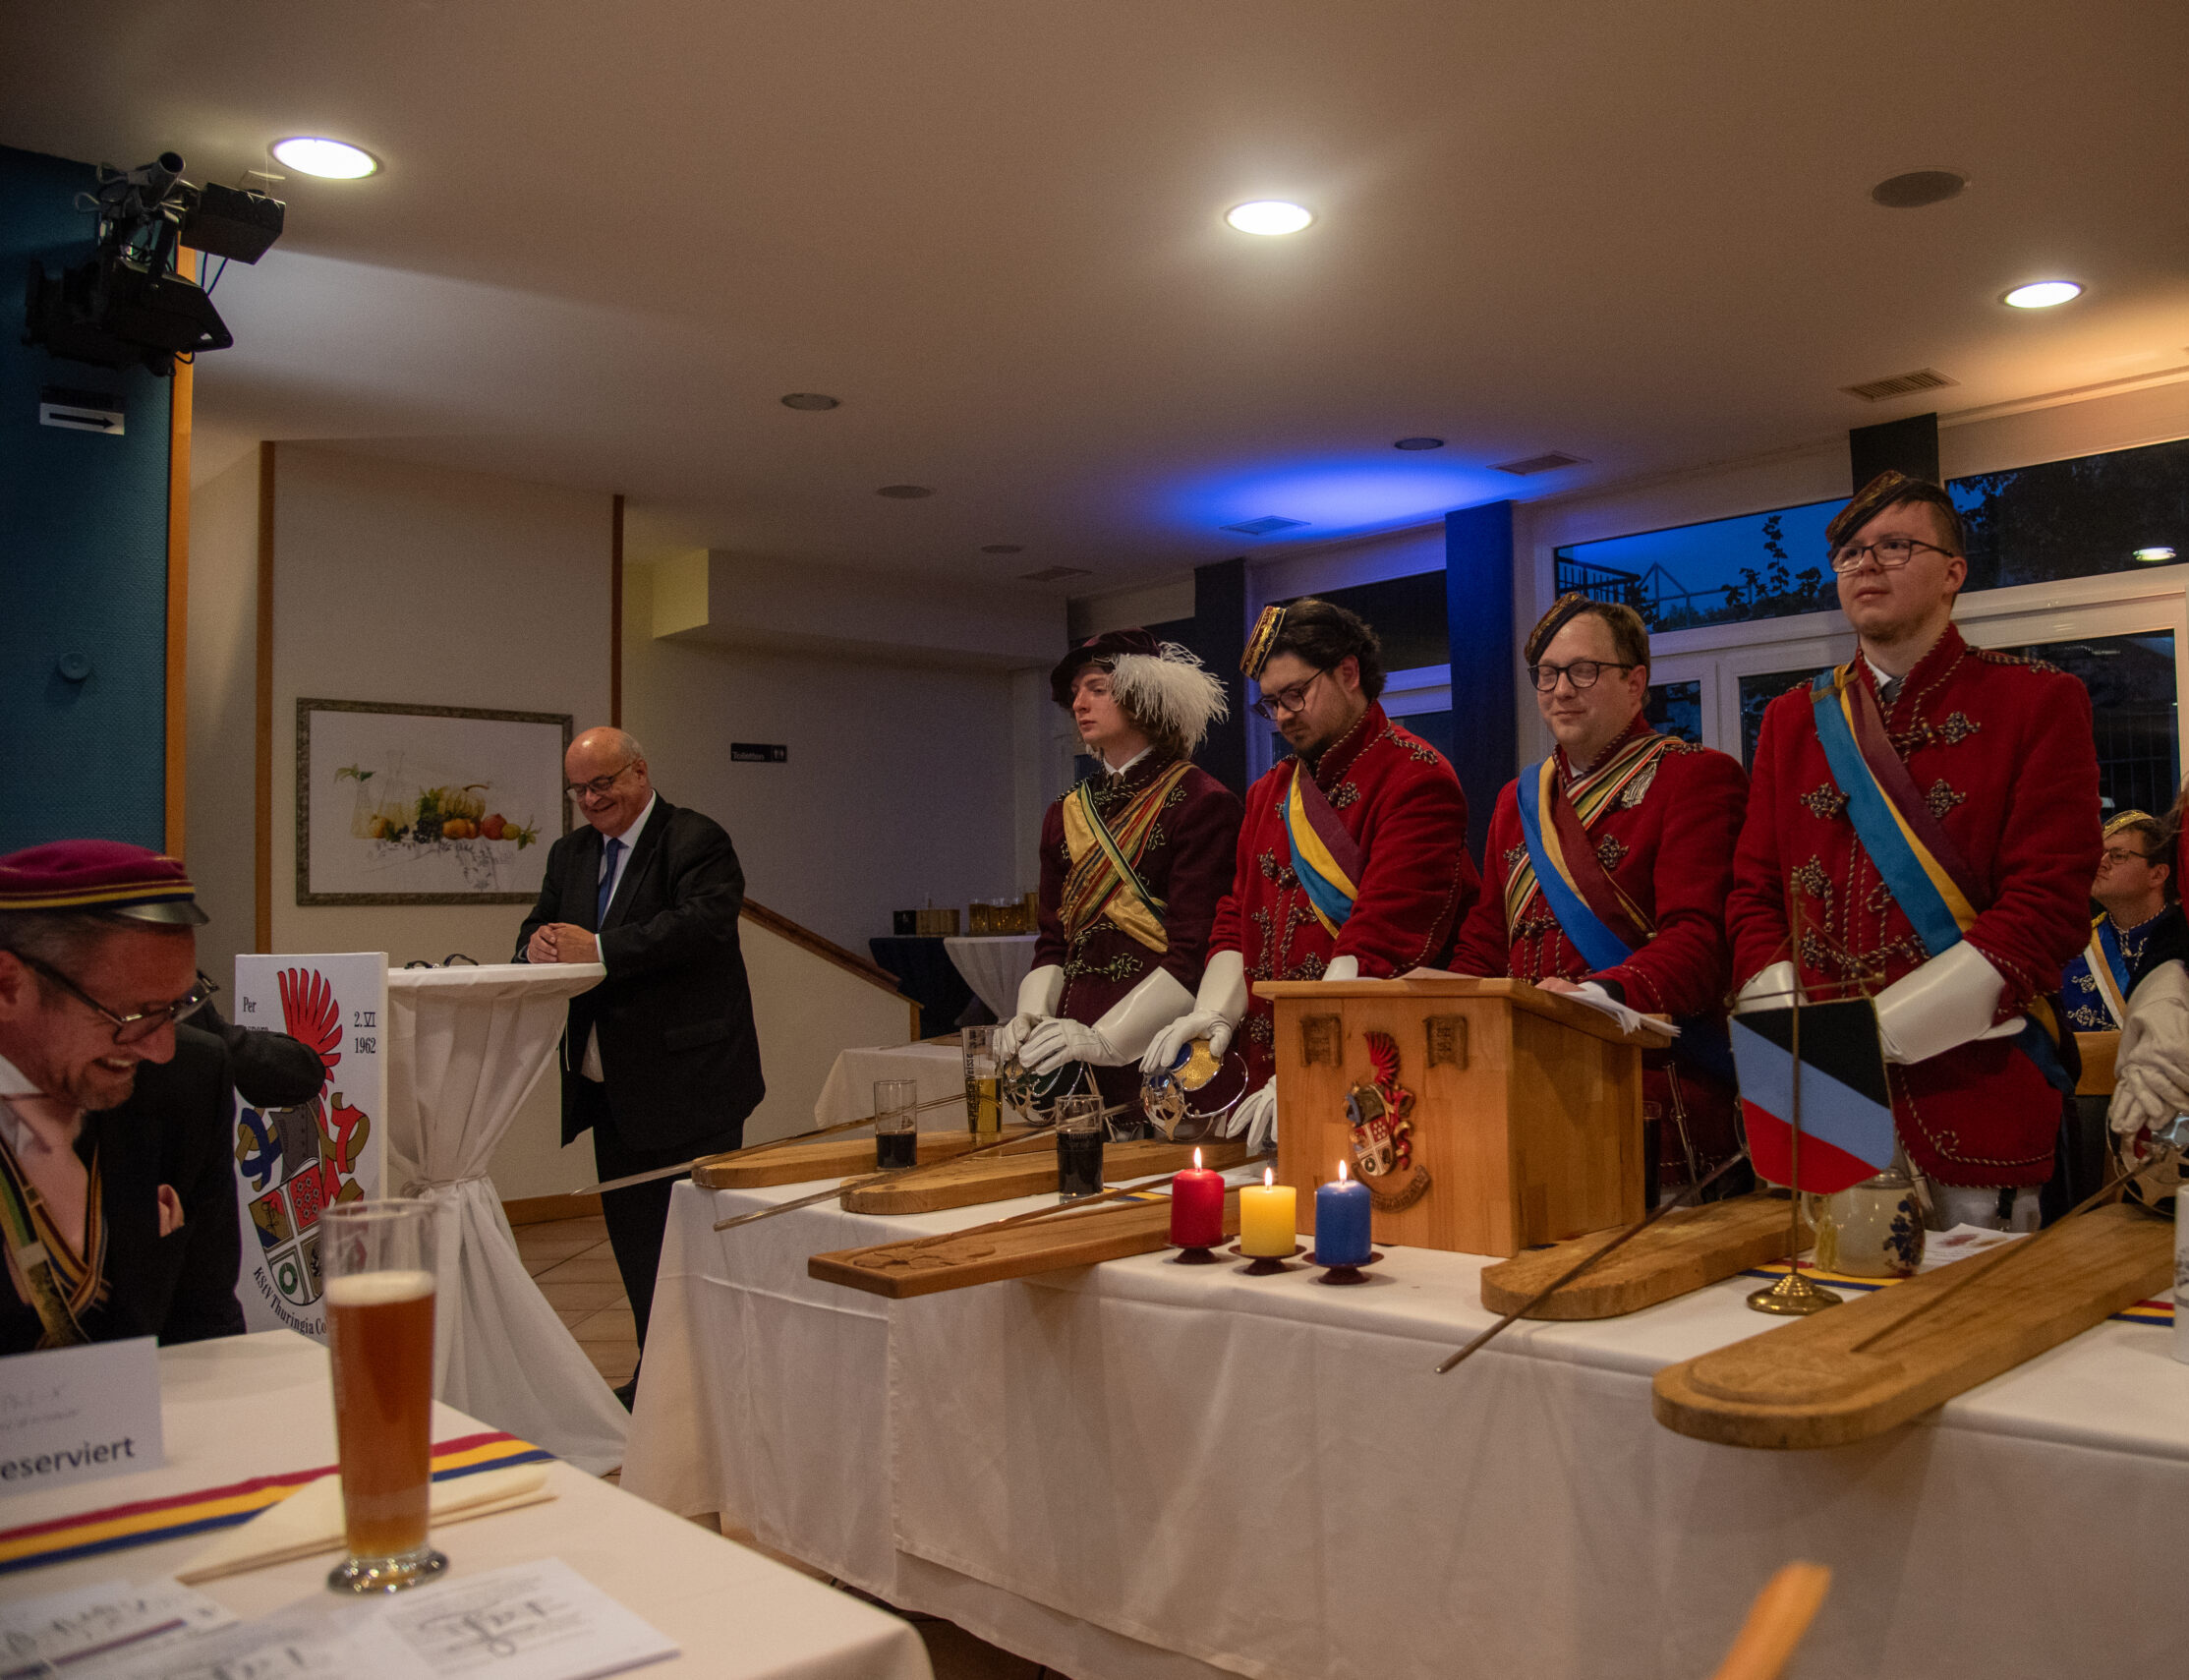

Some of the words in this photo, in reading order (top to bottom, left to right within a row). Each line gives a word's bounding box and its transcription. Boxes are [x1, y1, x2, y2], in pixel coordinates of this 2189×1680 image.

[243, 997, 257, 1014] Per
[354, 1037, 376, 1054] 1962
[253, 1266, 274, 1300] KStV
[269, 1293, 315, 1336] Thuringia
[316, 1317, 328, 1335] Co
[0, 1436, 135, 1481] eserviert
